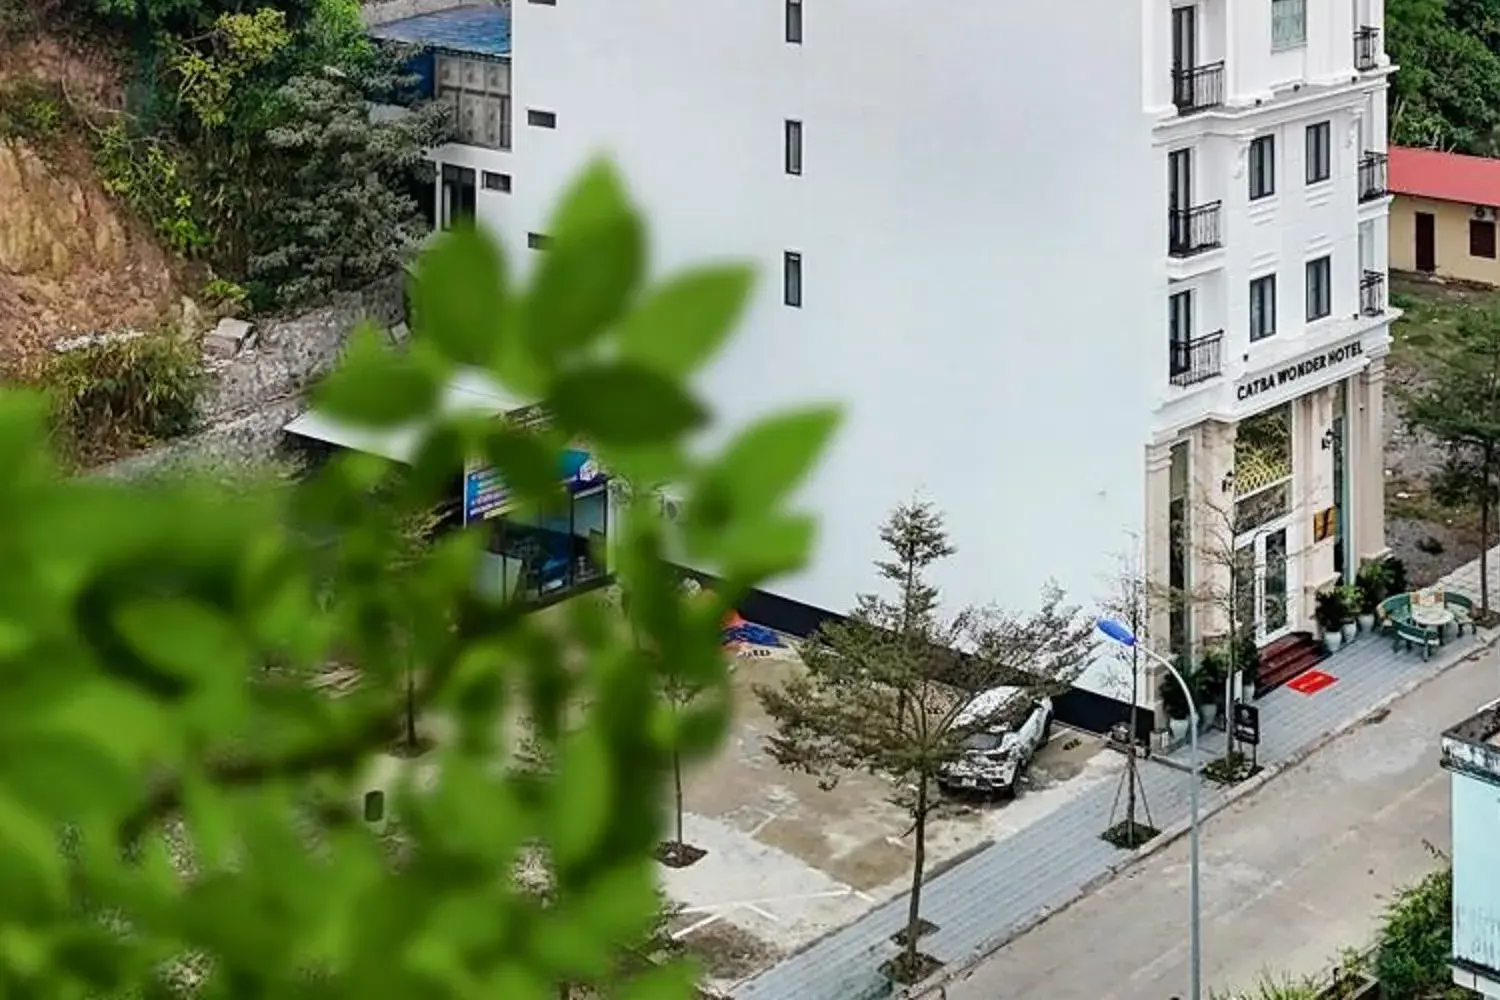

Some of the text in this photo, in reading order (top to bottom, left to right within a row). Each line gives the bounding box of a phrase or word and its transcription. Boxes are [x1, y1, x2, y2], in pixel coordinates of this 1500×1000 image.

[1237, 340, 1363, 400] CATBA WONDER HOTEL
